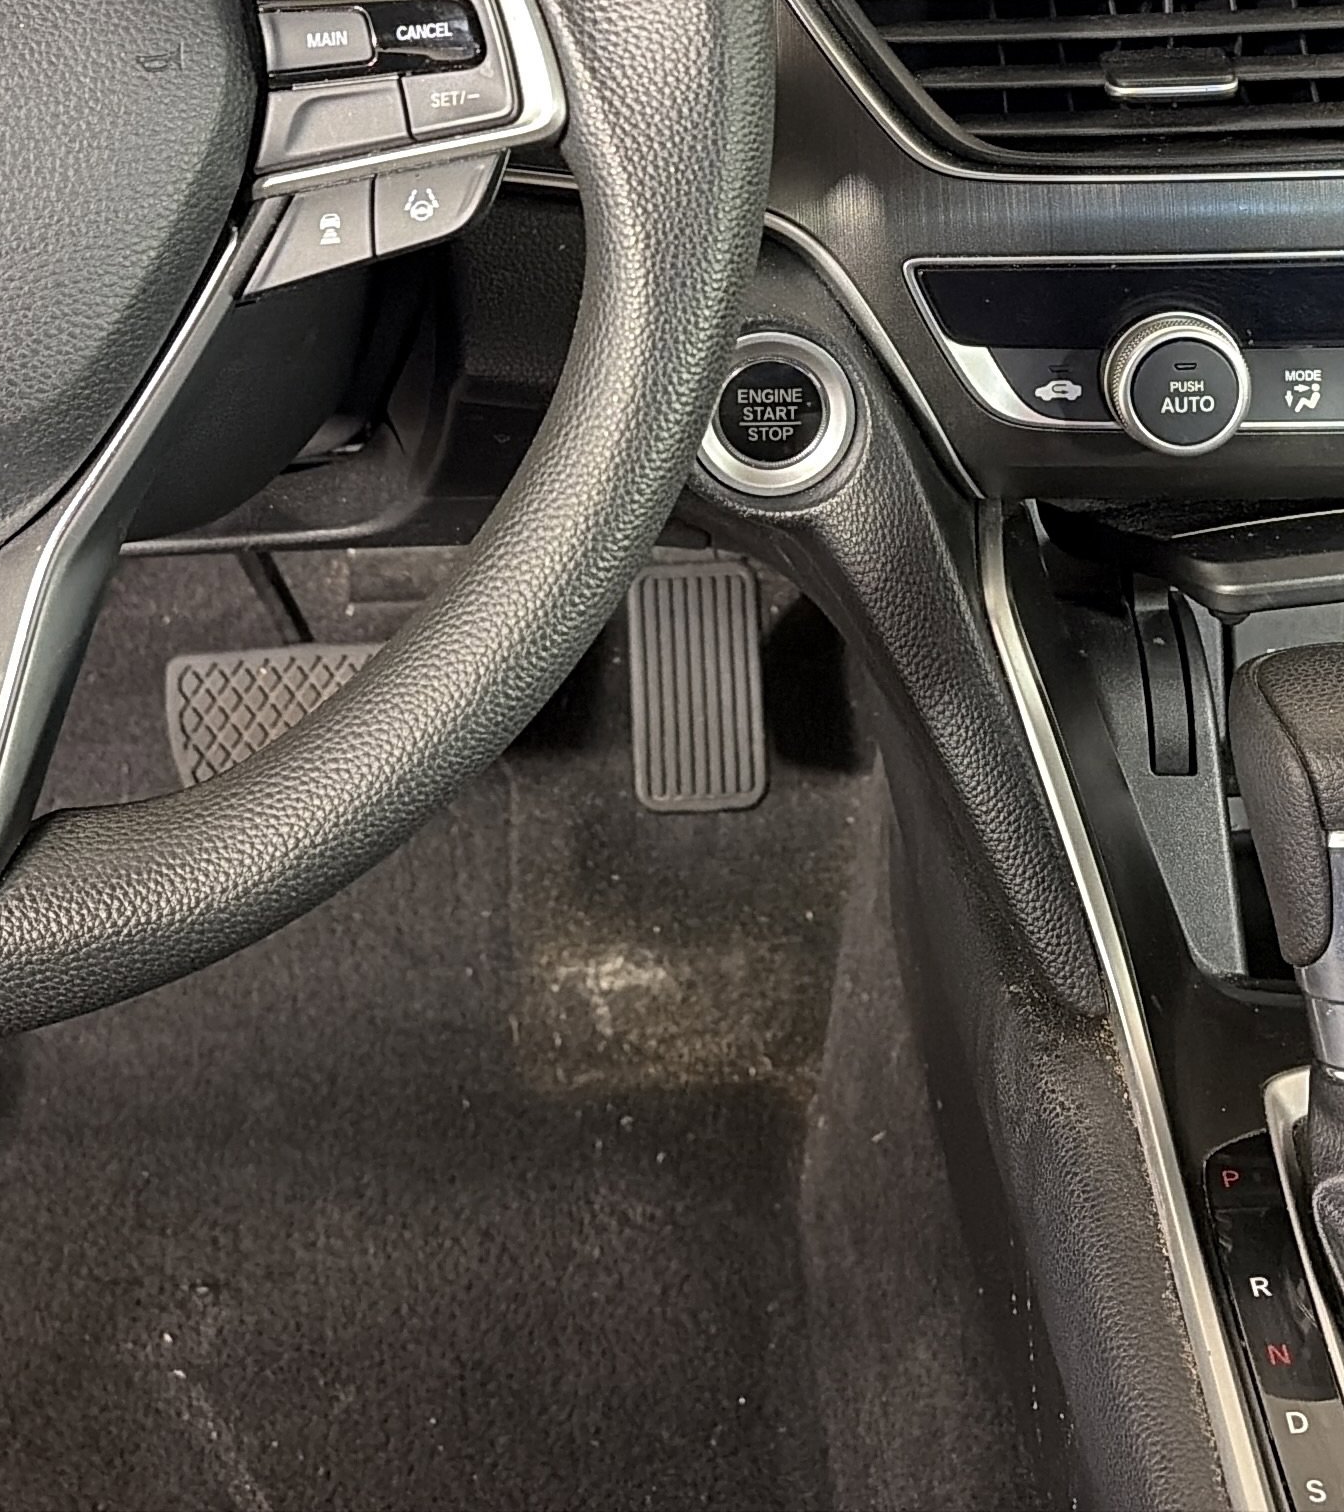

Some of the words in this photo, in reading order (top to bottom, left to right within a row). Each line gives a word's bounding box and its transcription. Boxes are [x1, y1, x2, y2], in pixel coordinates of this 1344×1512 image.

[306, 31, 348, 48] MAIN
[396, 22, 453, 41] CANCEL
[1284, 369, 1322, 382] MODE
[1169, 380, 1205, 393] PUSH
[737, 388, 803, 404] ENGINE
[743, 405, 798, 421] START
[1160, 396, 1215, 414] AUTO
[748, 426, 794, 442] STOP
[1222, 1170, 1239, 1187] P
[1249, 1276, 1272, 1298] R
[1266, 1344, 1293, 1365] N
[1285, 1411, 1309, 1435] D
[1306, 1479, 1327, 1503] S
